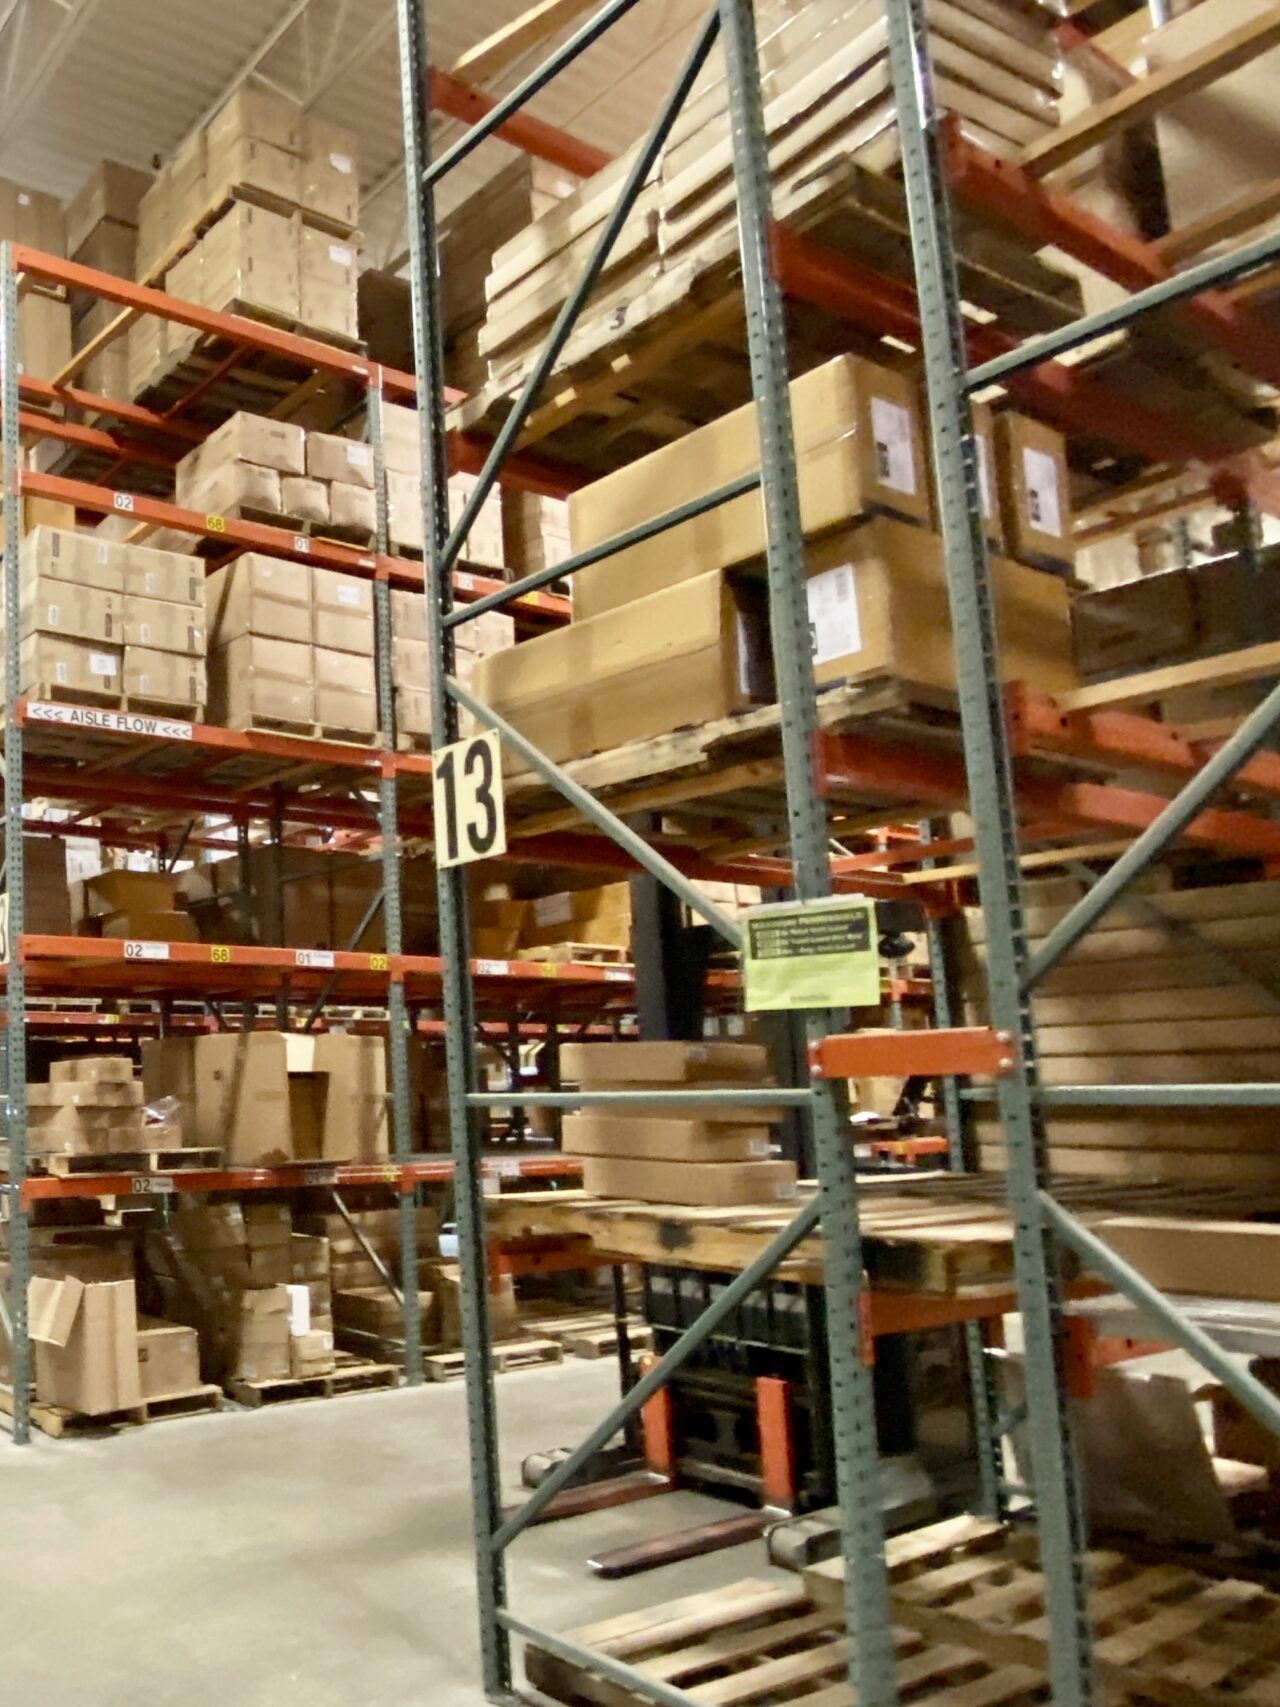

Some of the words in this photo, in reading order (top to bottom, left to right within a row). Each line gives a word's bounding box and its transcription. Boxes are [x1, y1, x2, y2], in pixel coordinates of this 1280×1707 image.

[116, 495, 132, 508] 02
[207, 517, 223, 530] 68
[296, 537, 309, 550] 01
[70, 709, 111, 727] AISLE
[117, 716, 157, 734] FLOW
[436, 738, 498, 860] 13
[126, 944, 142, 957] 02
[212, 948, 228, 961] 68
[298, 952, 311, 964] 01
[371, 957, 386, 969] 02
[134, 1178, 150, 1192] 02
